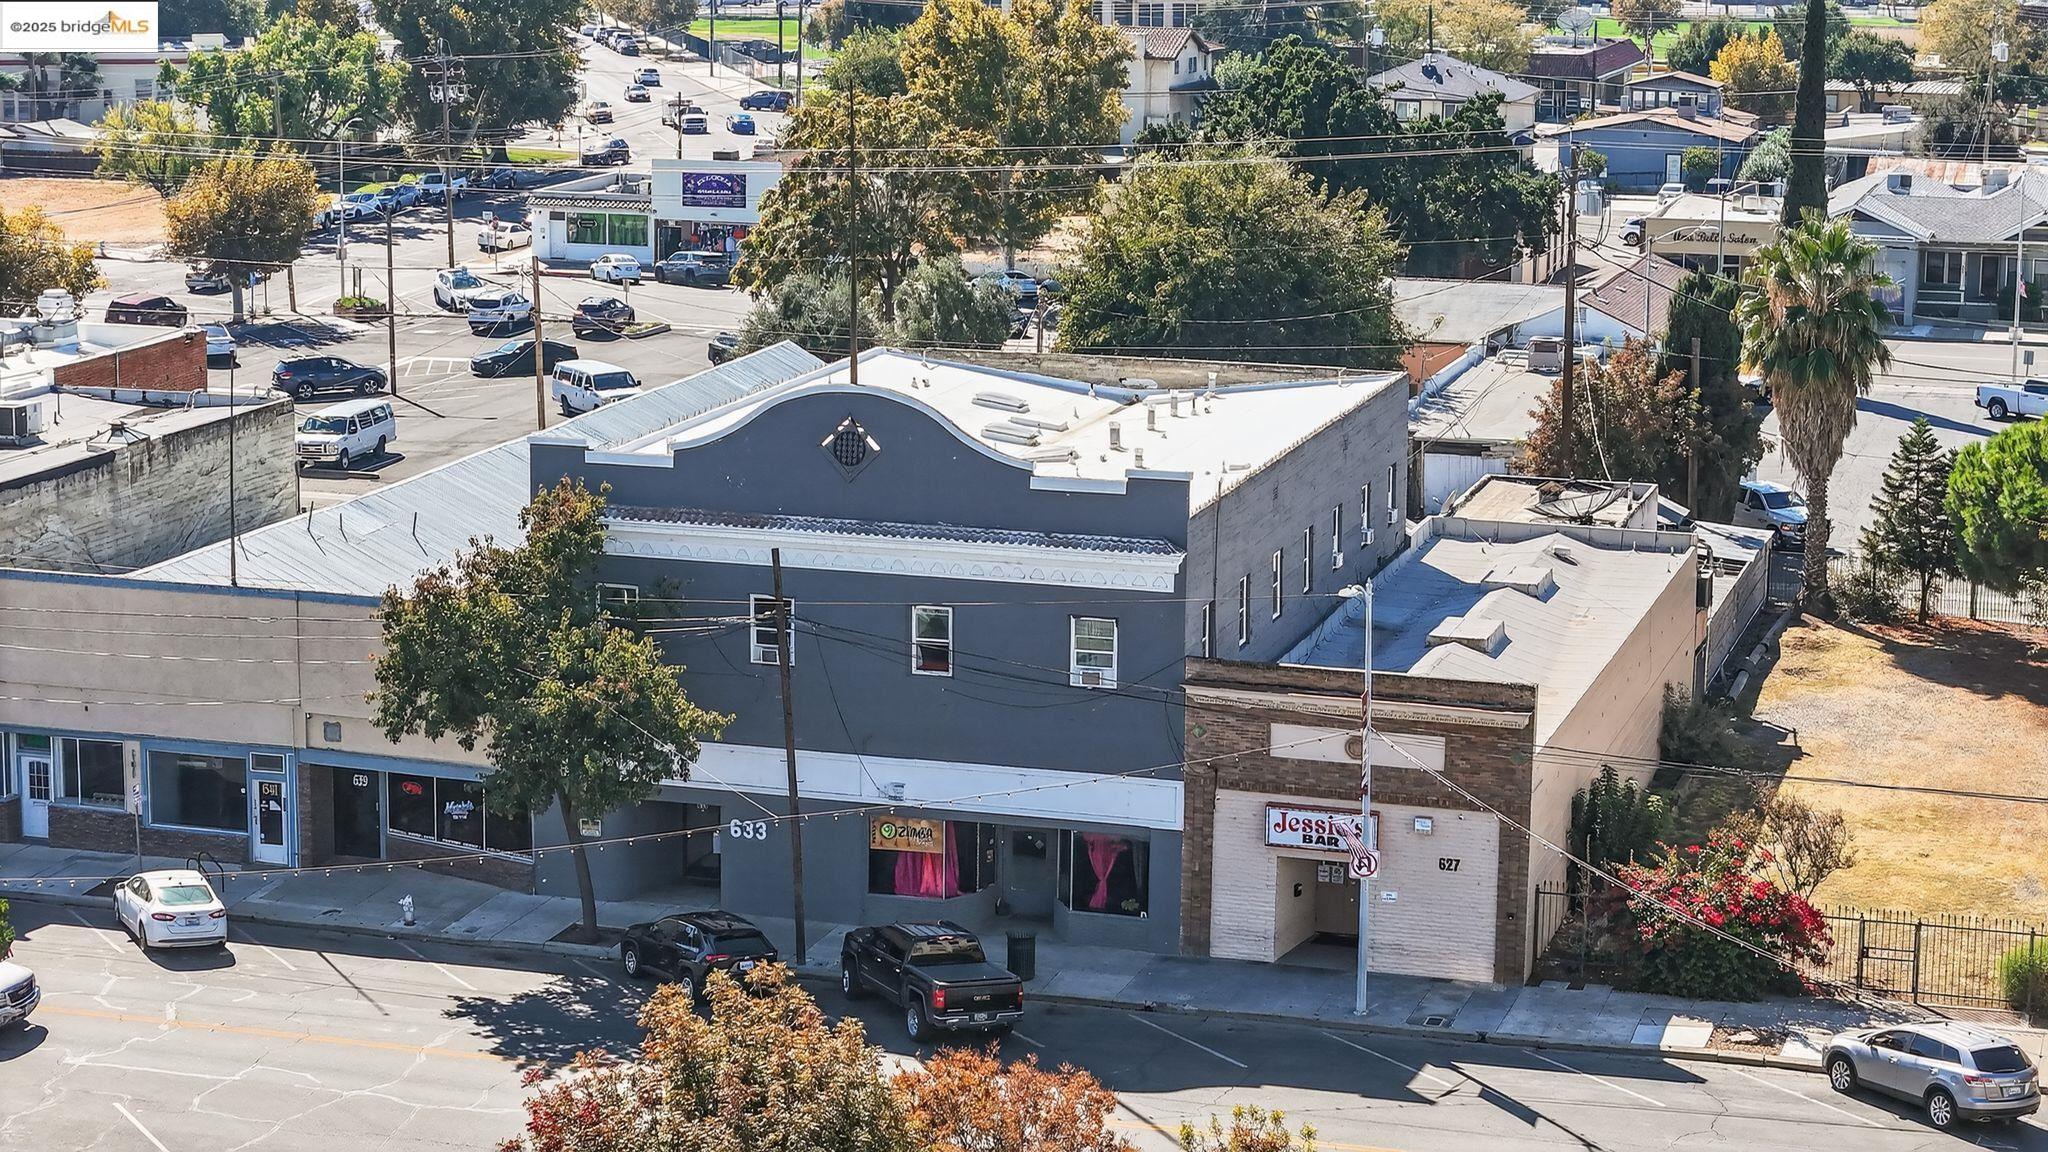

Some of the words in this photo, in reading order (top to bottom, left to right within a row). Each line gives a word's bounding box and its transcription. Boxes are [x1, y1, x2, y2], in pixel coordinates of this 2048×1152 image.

[730, 819, 767, 840] 633
[1273, 811, 1363, 840] Jessi's
[1302, 833, 1340, 848] BAR
[1438, 857, 1461, 872] 627
